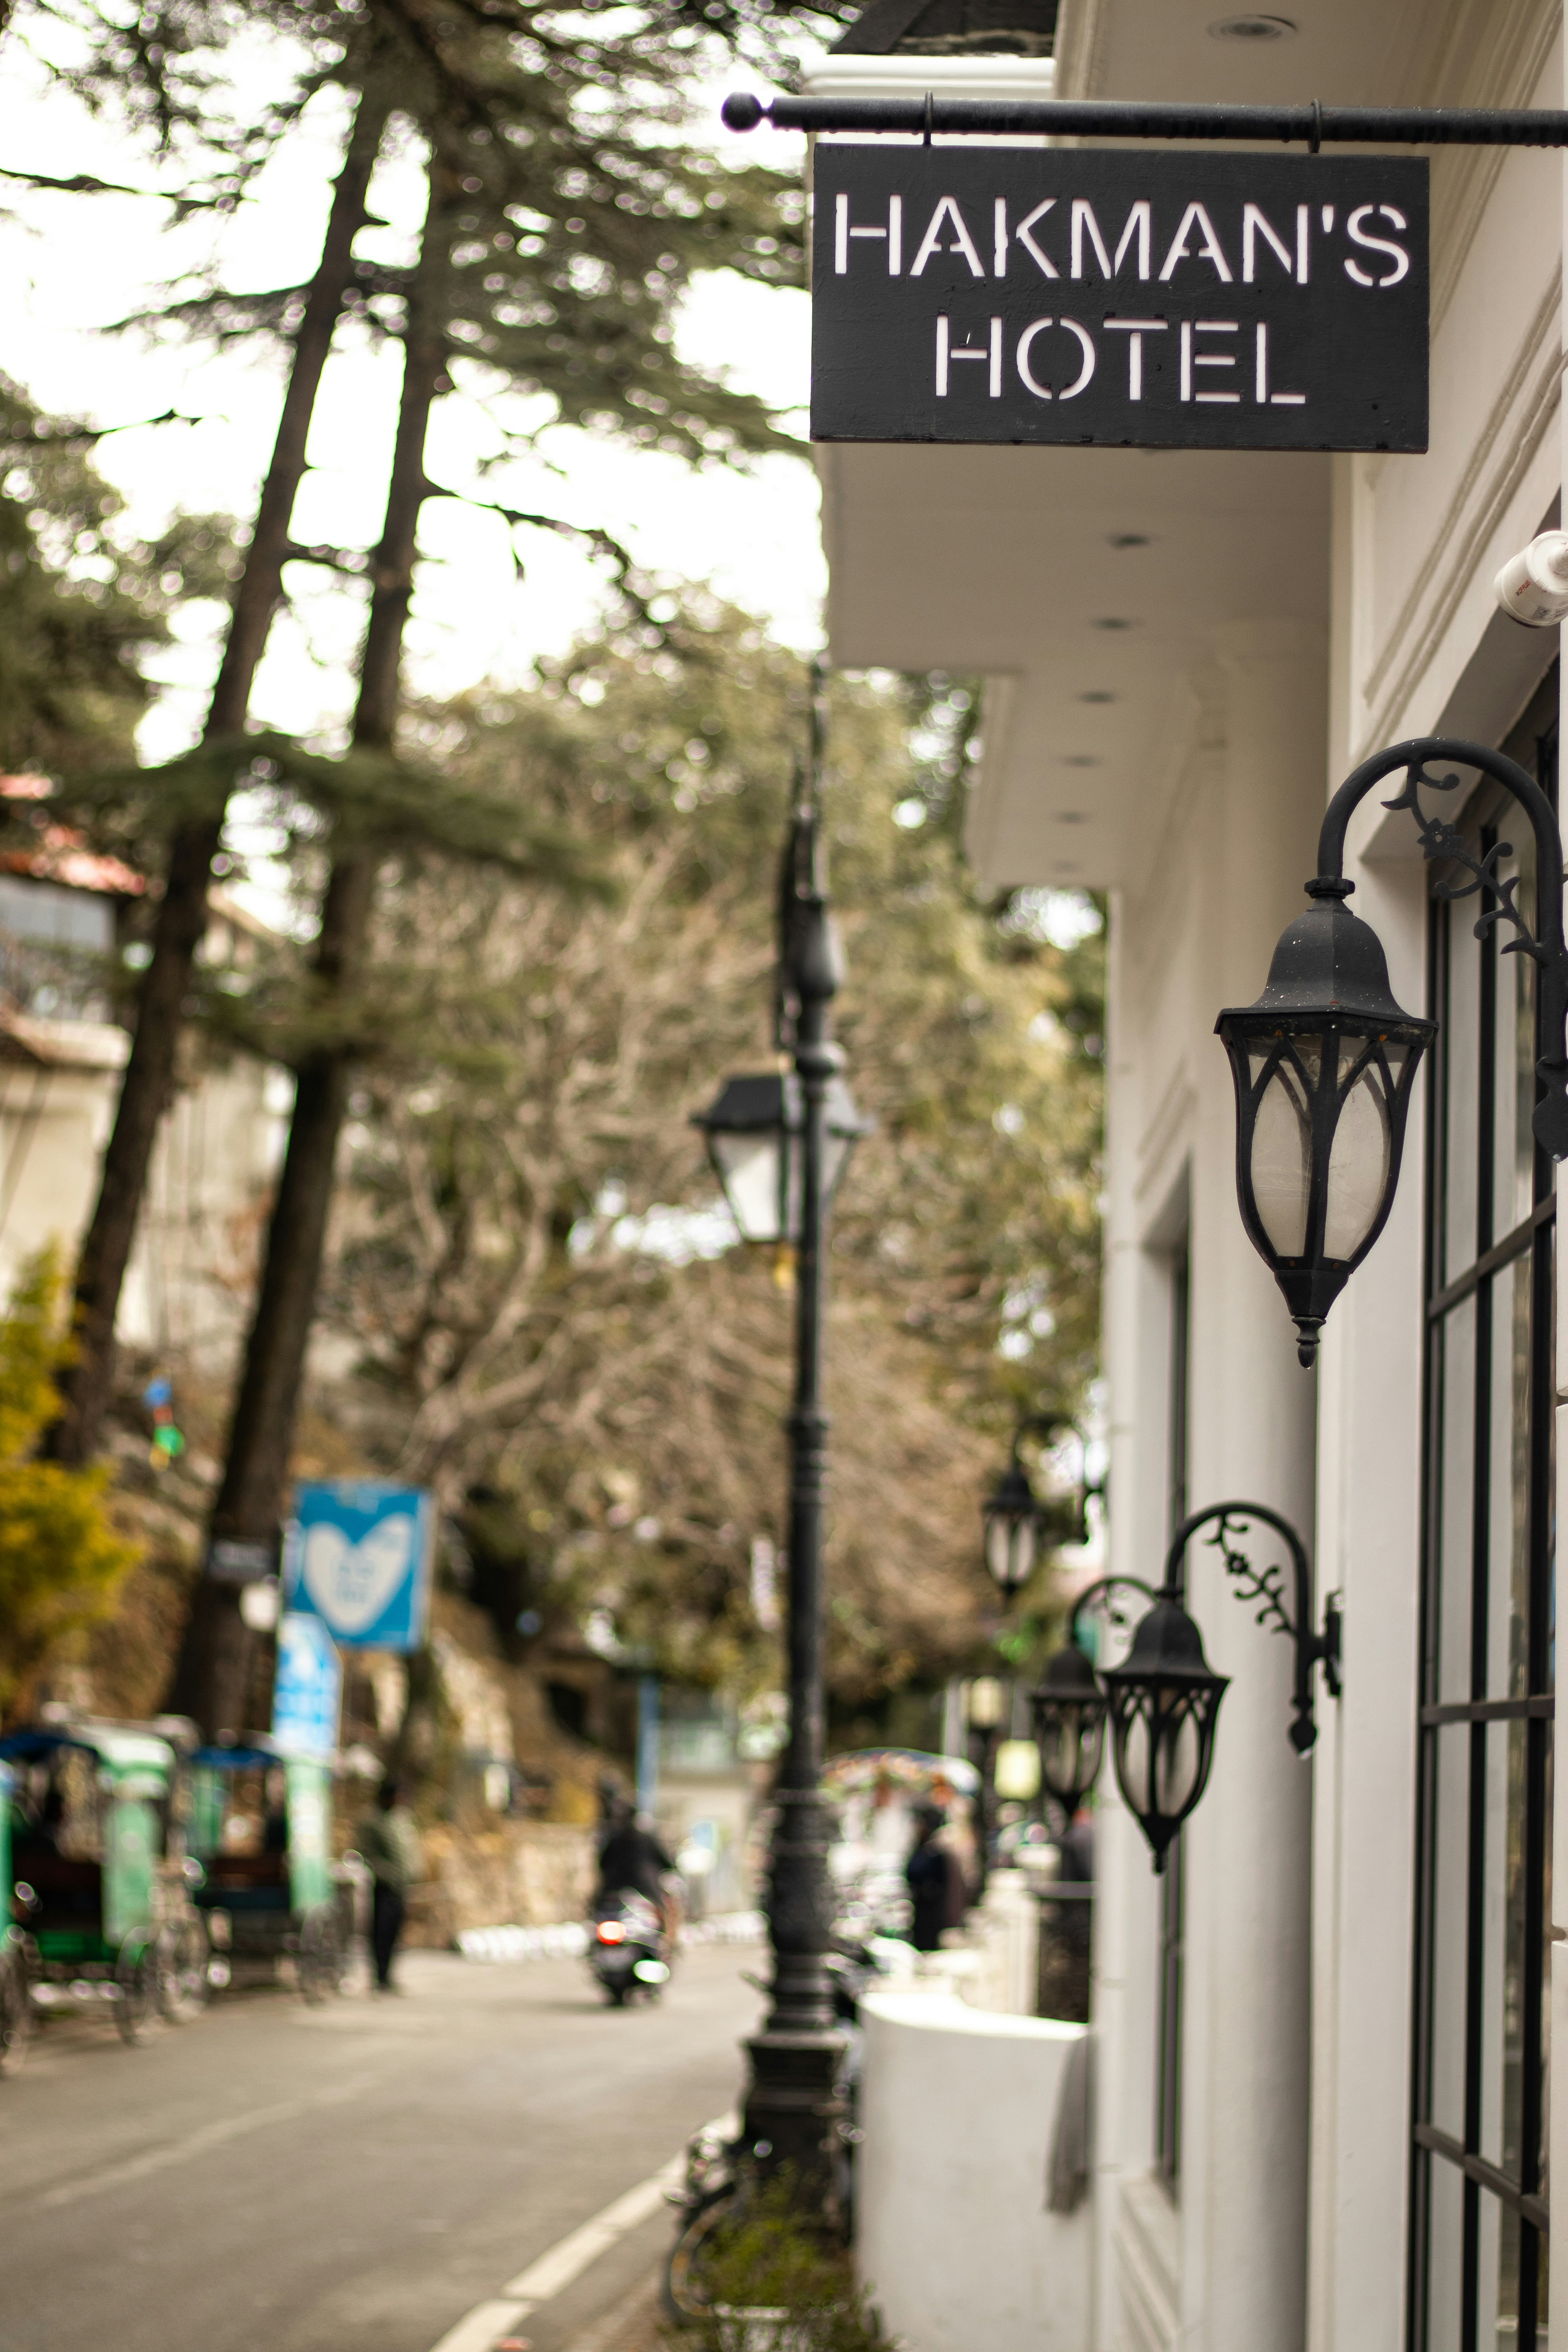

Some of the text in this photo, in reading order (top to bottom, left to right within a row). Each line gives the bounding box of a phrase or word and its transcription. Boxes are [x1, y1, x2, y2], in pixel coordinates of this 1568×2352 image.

[835, 193, 1409, 287] HAKMAN'S
[935, 315, 1306, 404] HOTEL
[1522, 580, 1530, 590] PLUS
